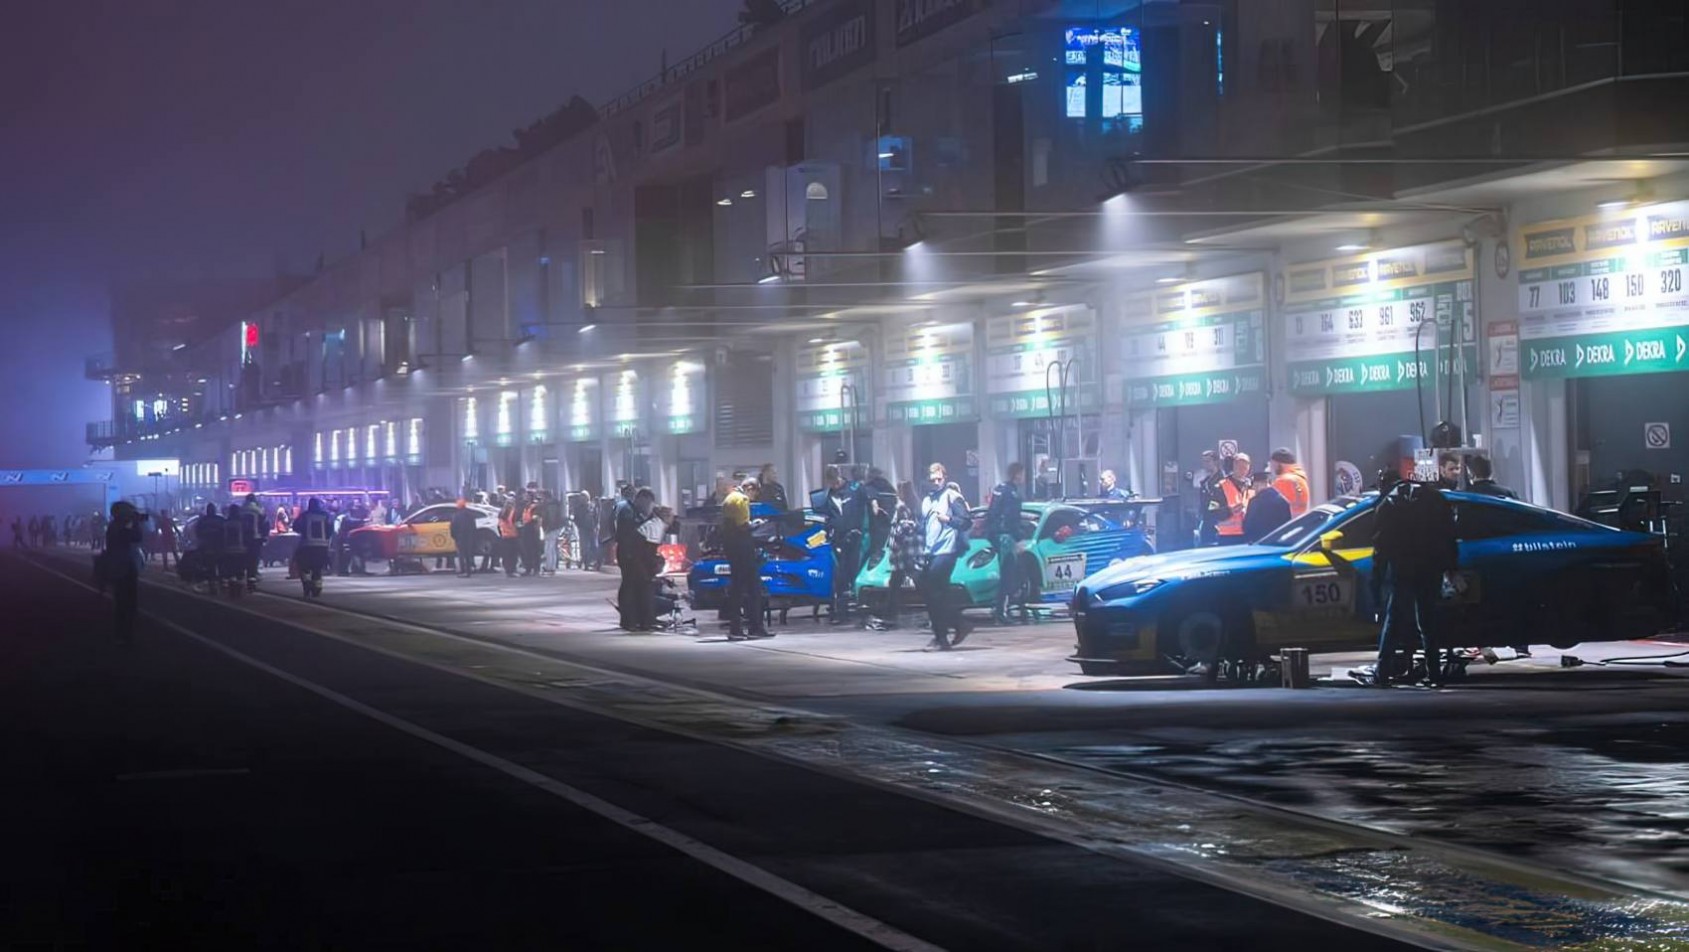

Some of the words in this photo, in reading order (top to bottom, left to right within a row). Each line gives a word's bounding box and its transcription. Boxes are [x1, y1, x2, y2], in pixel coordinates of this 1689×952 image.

[1591, 277, 1610, 301] 148
[1625, 273, 1645, 298] 150
[1660, 268, 1682, 294] 320
[1529, 285, 1541, 309] 77
[1558, 282, 1576, 305] 103
[1539, 348, 1567, 368] DEKRA
[1586, 344, 1615, 364] DEKRA
[1636, 340, 1666, 360] DEKRA
[1333, 367, 1354, 384] DEKRA
[1055, 564, 1072, 579] 44
[1301, 582, 1341, 604] 150
